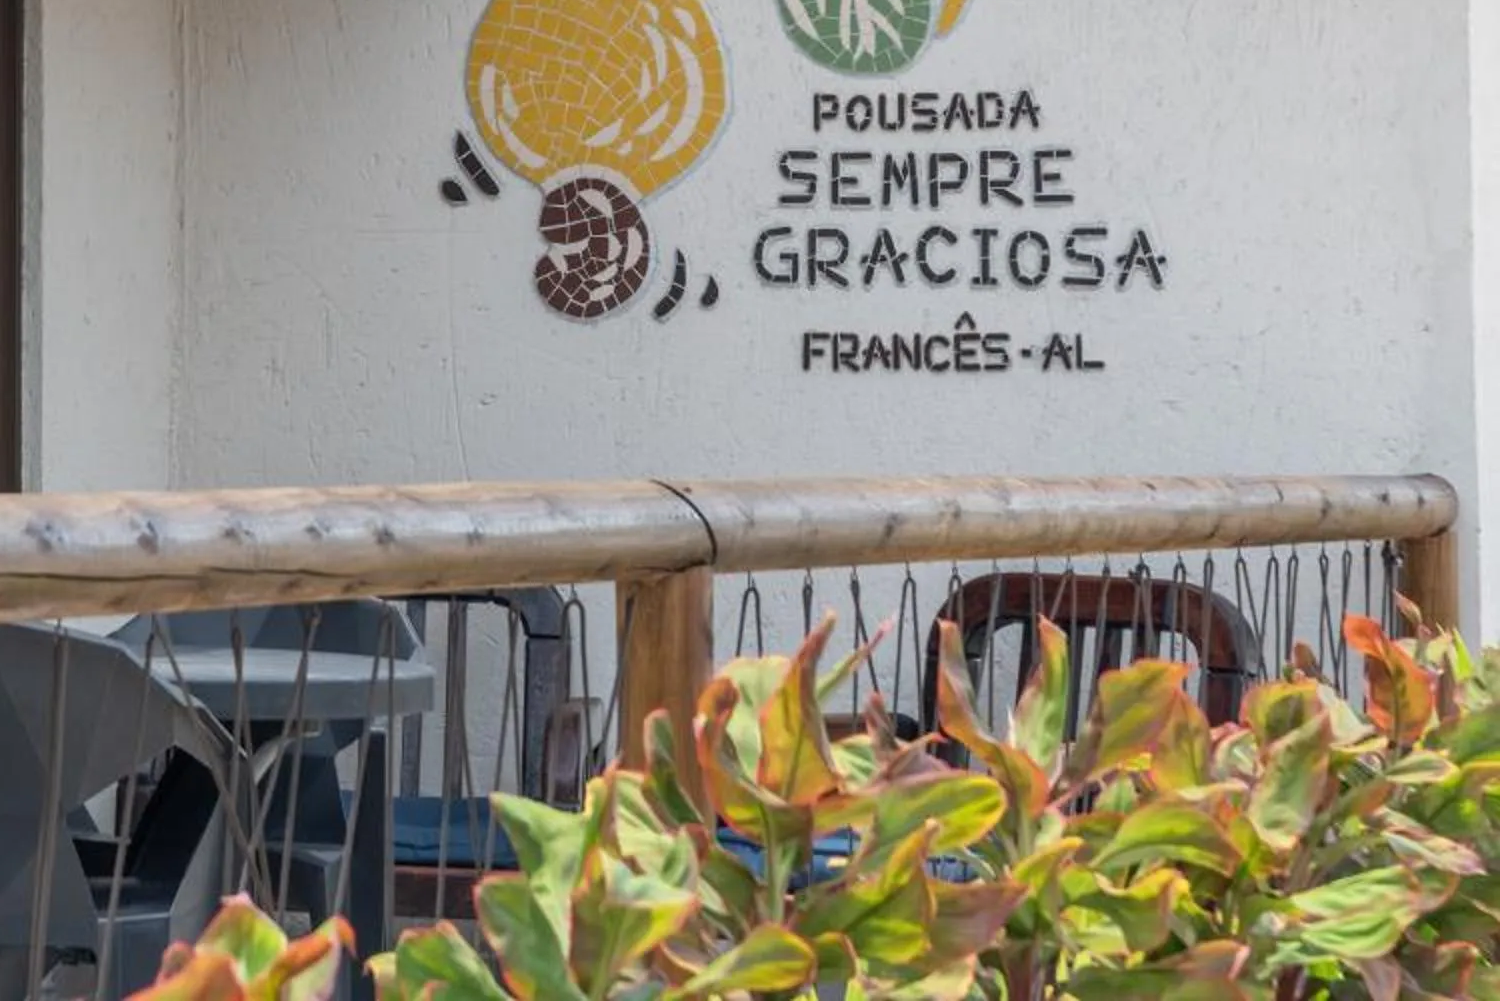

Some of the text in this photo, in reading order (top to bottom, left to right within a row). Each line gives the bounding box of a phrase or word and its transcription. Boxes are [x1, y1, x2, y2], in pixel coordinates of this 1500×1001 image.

[812, 89, 1041, 133] POUSADA
[777, 148, 1075, 209] SEMPRE
[751, 224, 1168, 288] GRACIOSA
